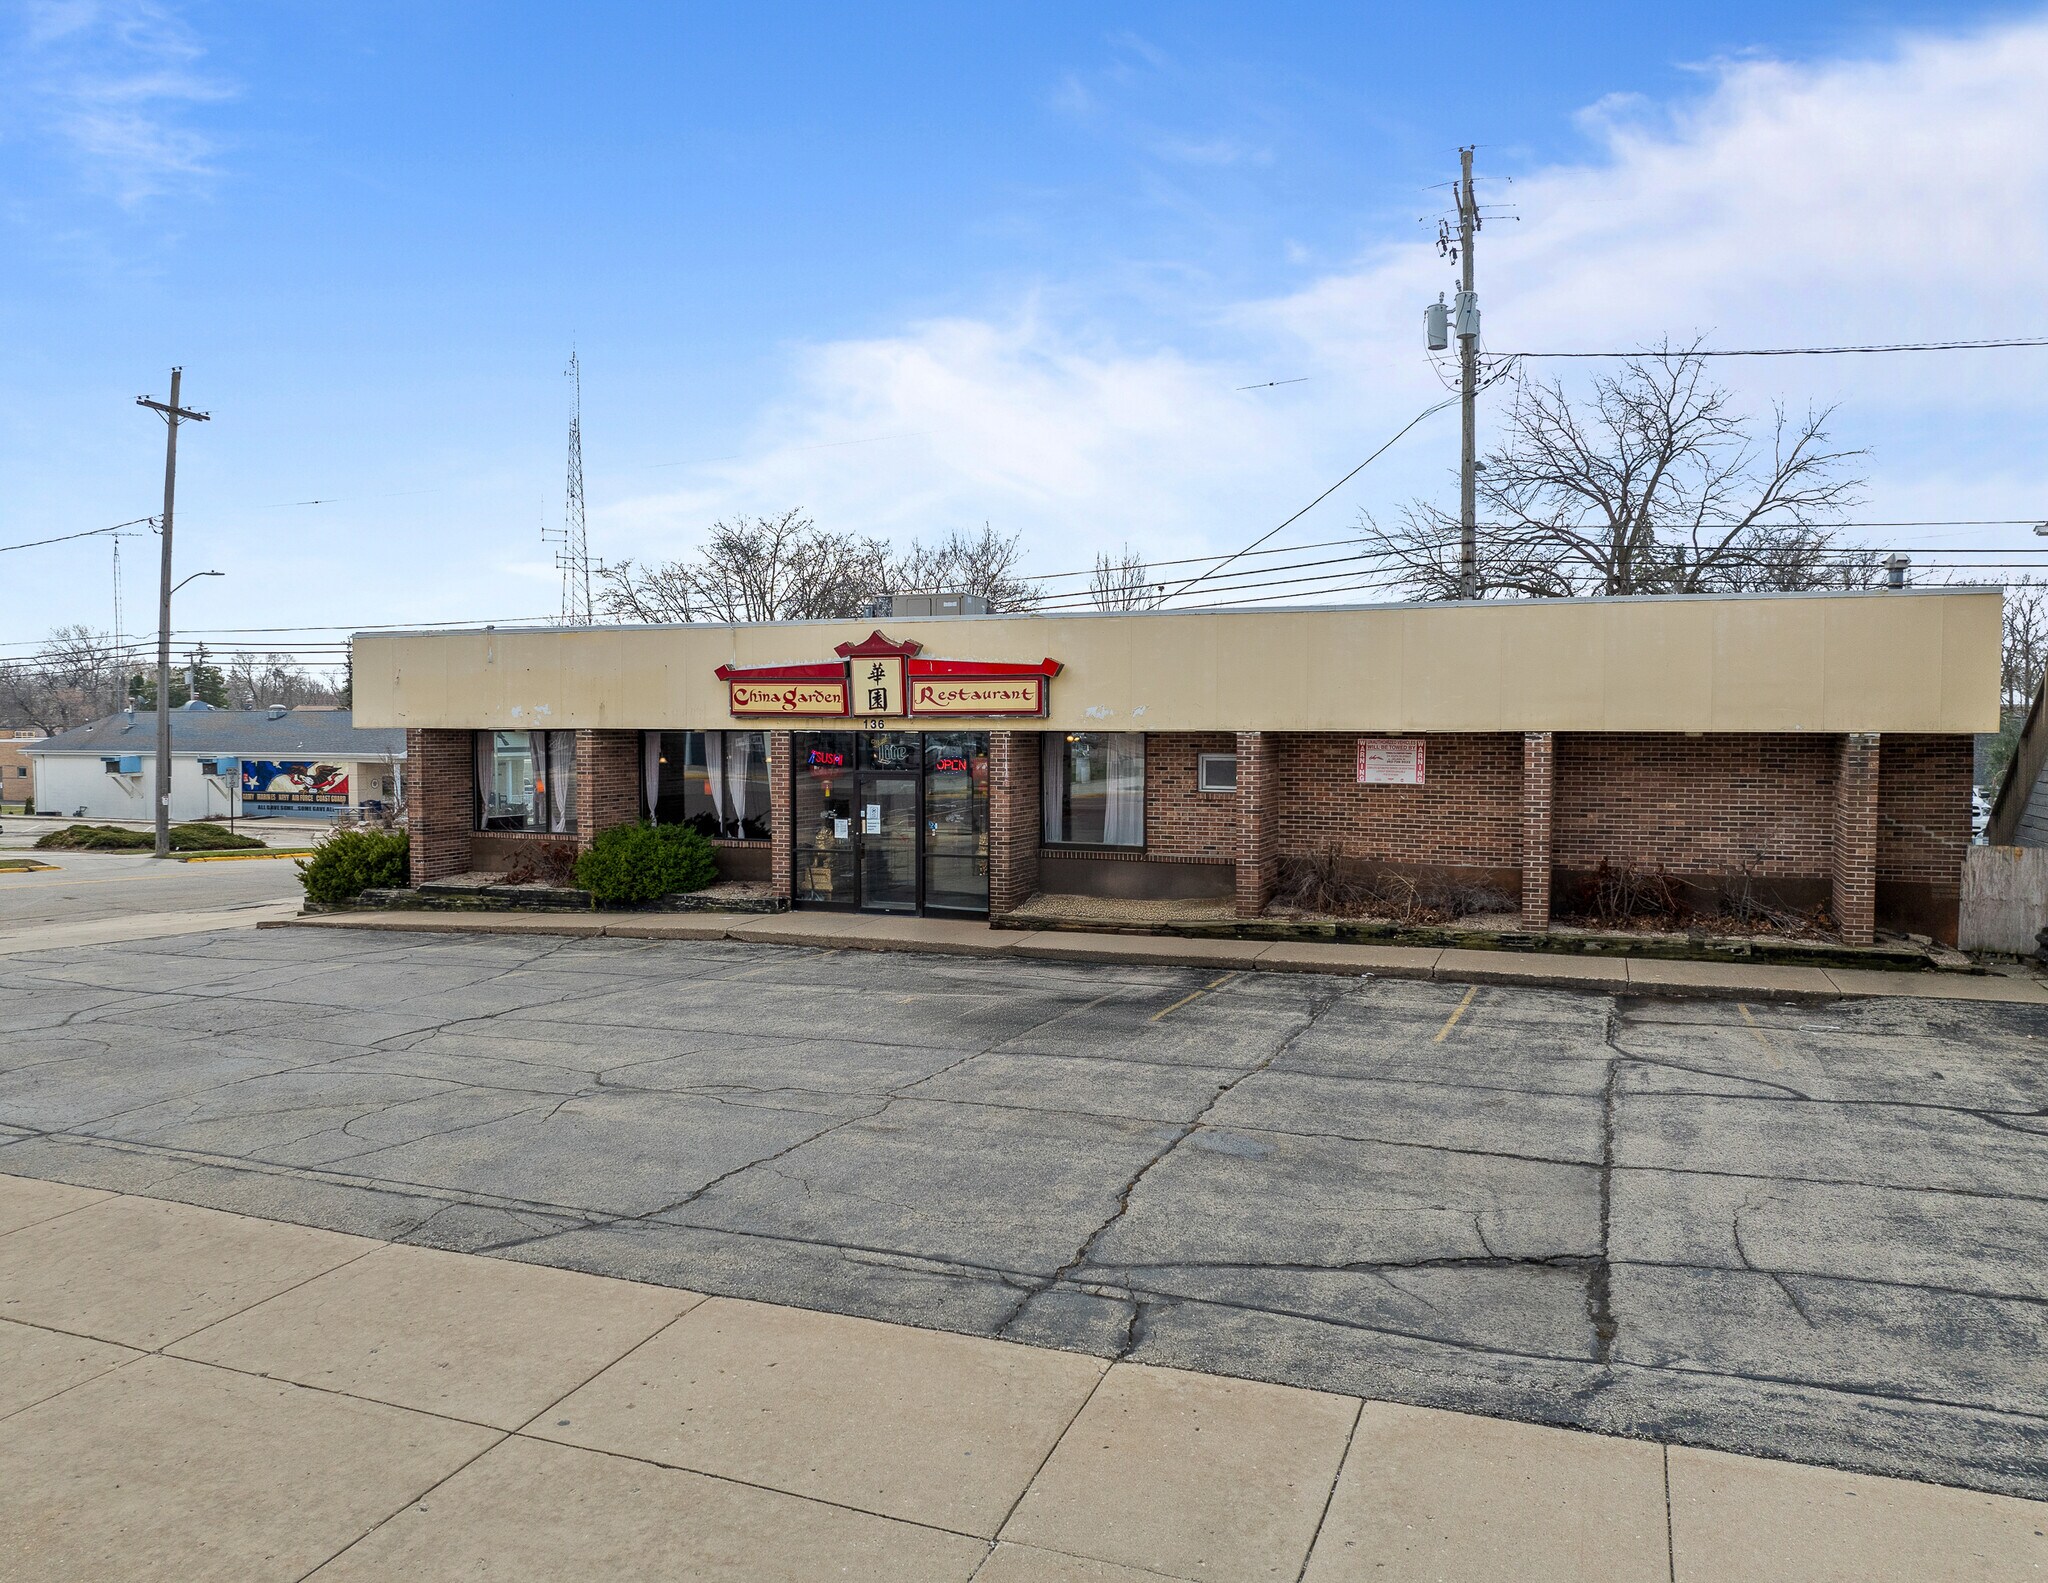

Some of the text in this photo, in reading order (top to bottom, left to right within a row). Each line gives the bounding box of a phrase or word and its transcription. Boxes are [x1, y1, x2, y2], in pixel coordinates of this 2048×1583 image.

[867, 662, 888, 712] 華園
[733, 688, 781, 706] China
[915, 686, 1035, 707] Restaurant
[863, 719, 885, 730] 136
[815, 751, 843, 766] SUSHI
[936, 759, 967, 771] OPEN
[300, 794, 314, 802] FORCE
[316, 794, 331, 802] COAST
